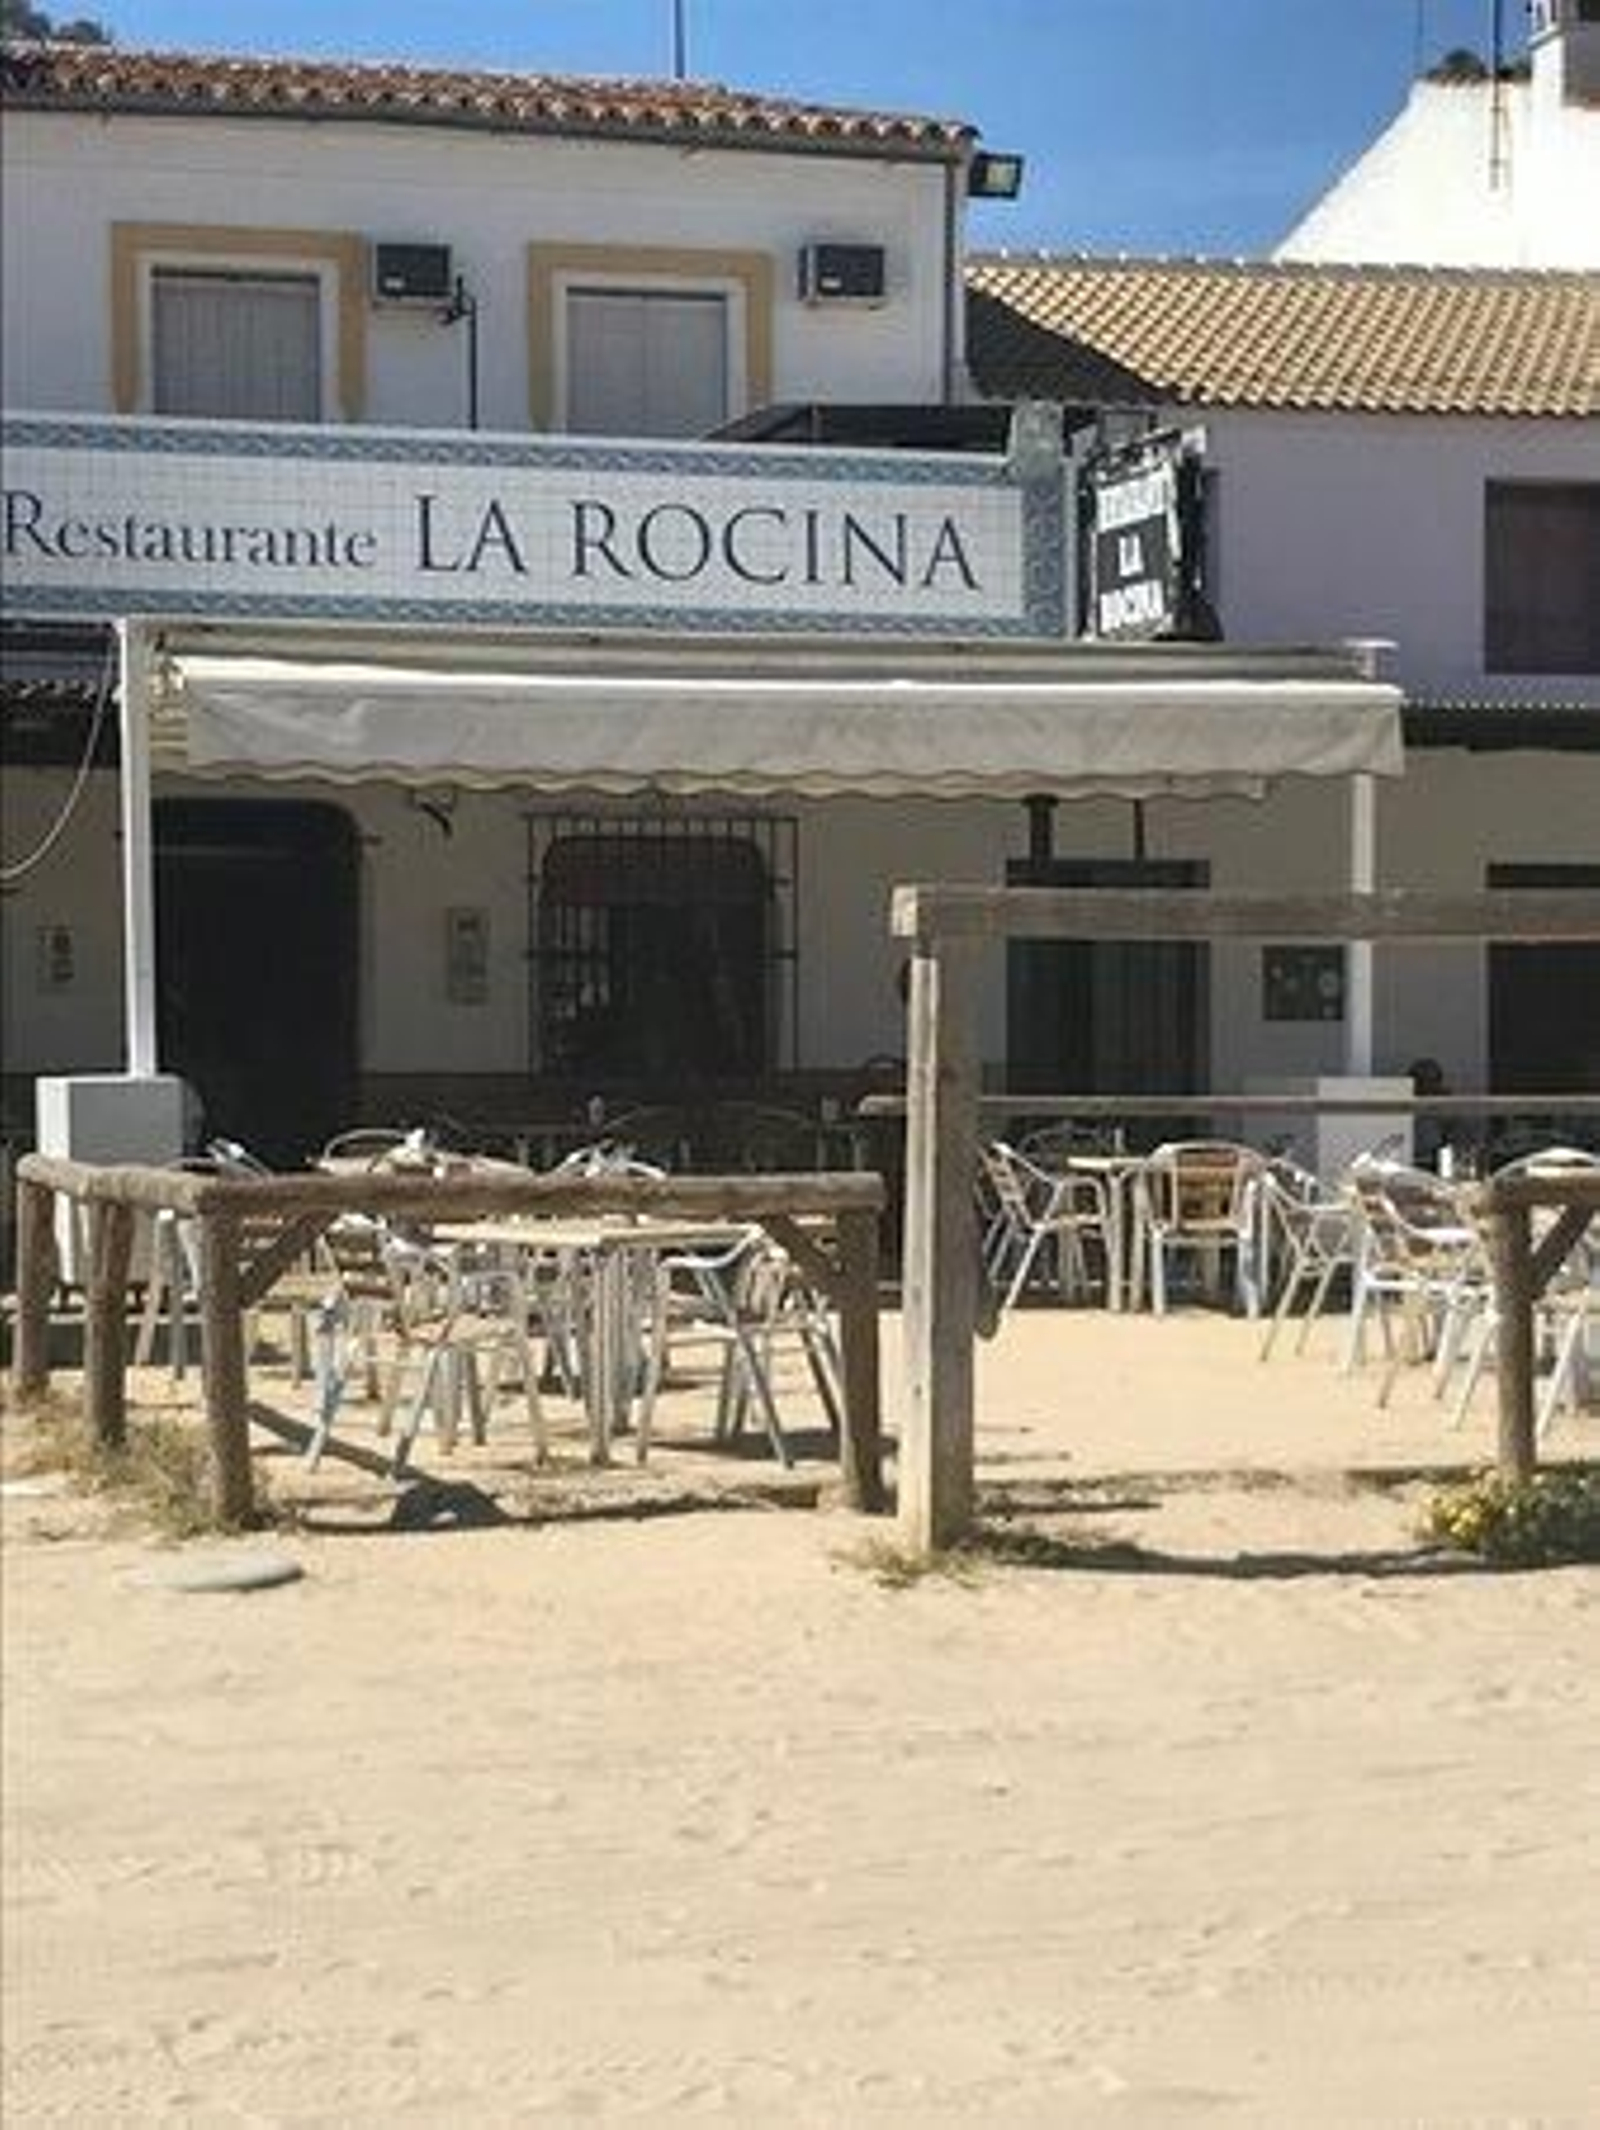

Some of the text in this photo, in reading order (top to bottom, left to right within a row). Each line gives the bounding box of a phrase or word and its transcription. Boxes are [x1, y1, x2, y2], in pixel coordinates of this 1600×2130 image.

[1, 490, 981, 590] Restaurante LA ROCINA
